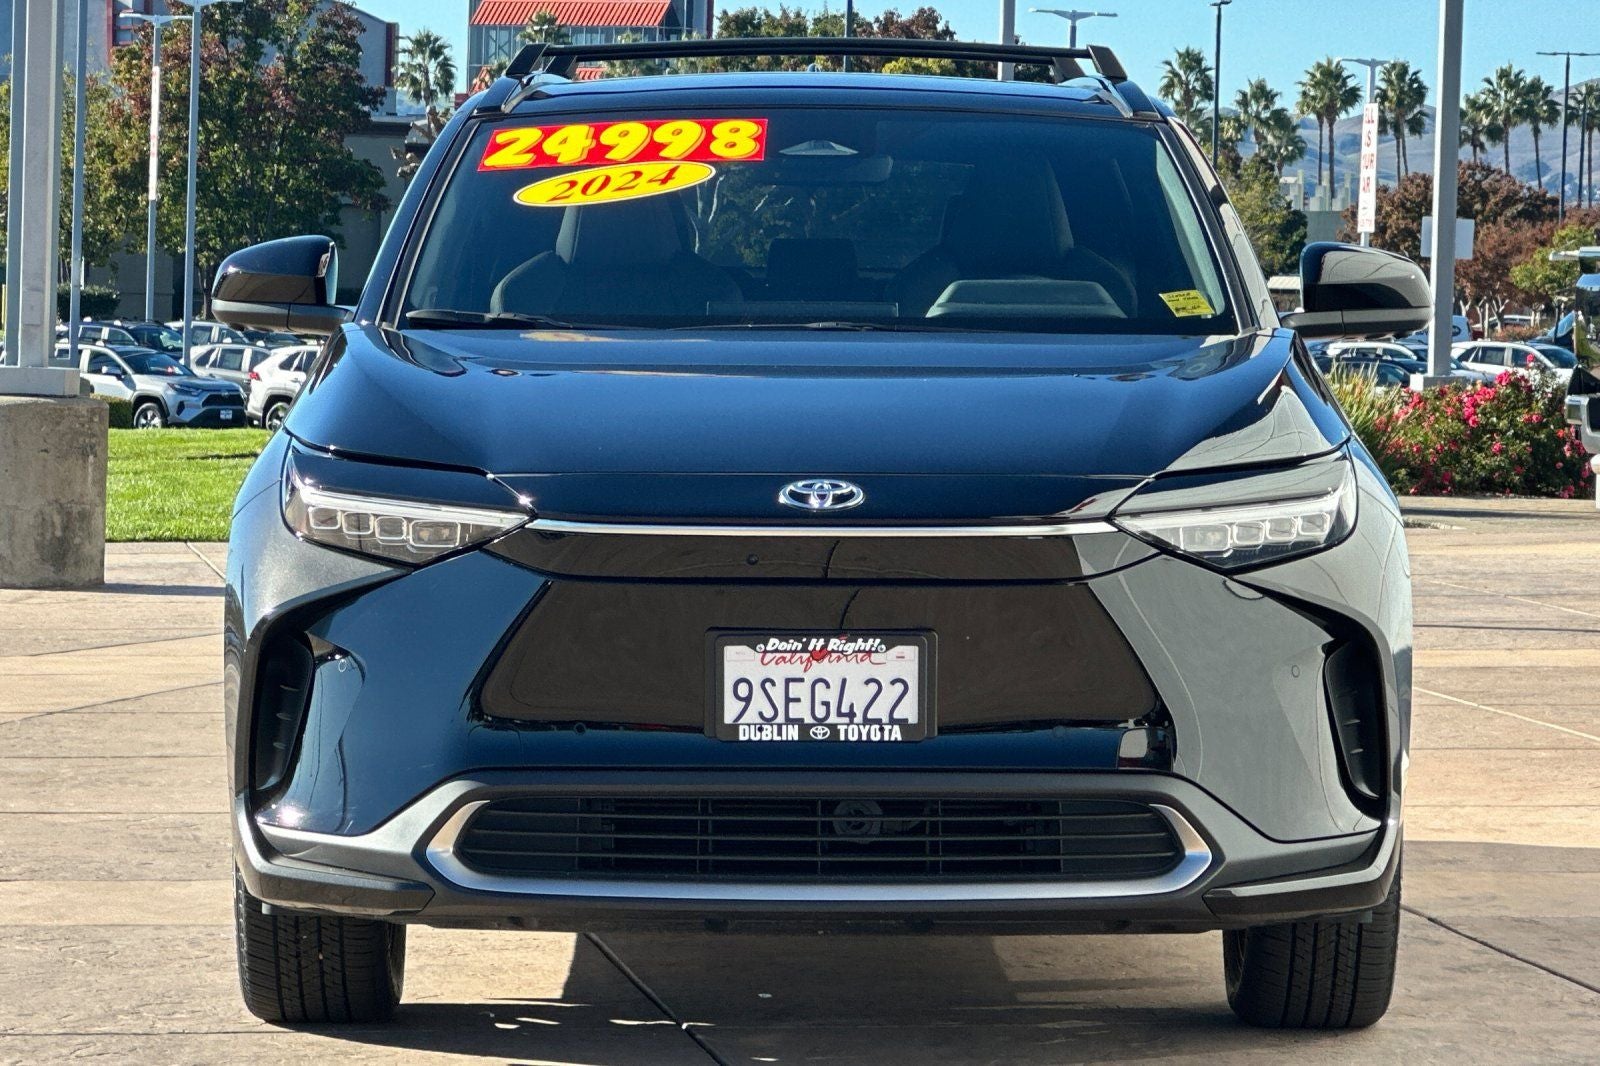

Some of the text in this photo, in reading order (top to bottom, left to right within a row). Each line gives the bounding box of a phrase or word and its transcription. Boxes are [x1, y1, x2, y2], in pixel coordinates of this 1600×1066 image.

[484, 119, 762, 167] 24998
[545, 165, 681, 203] 2024
[766, 638, 880, 655] Doin' It Right!
[732, 677, 910, 724] 9SEG422
[738, 724, 902, 741] DUBLIN TOYOTA
